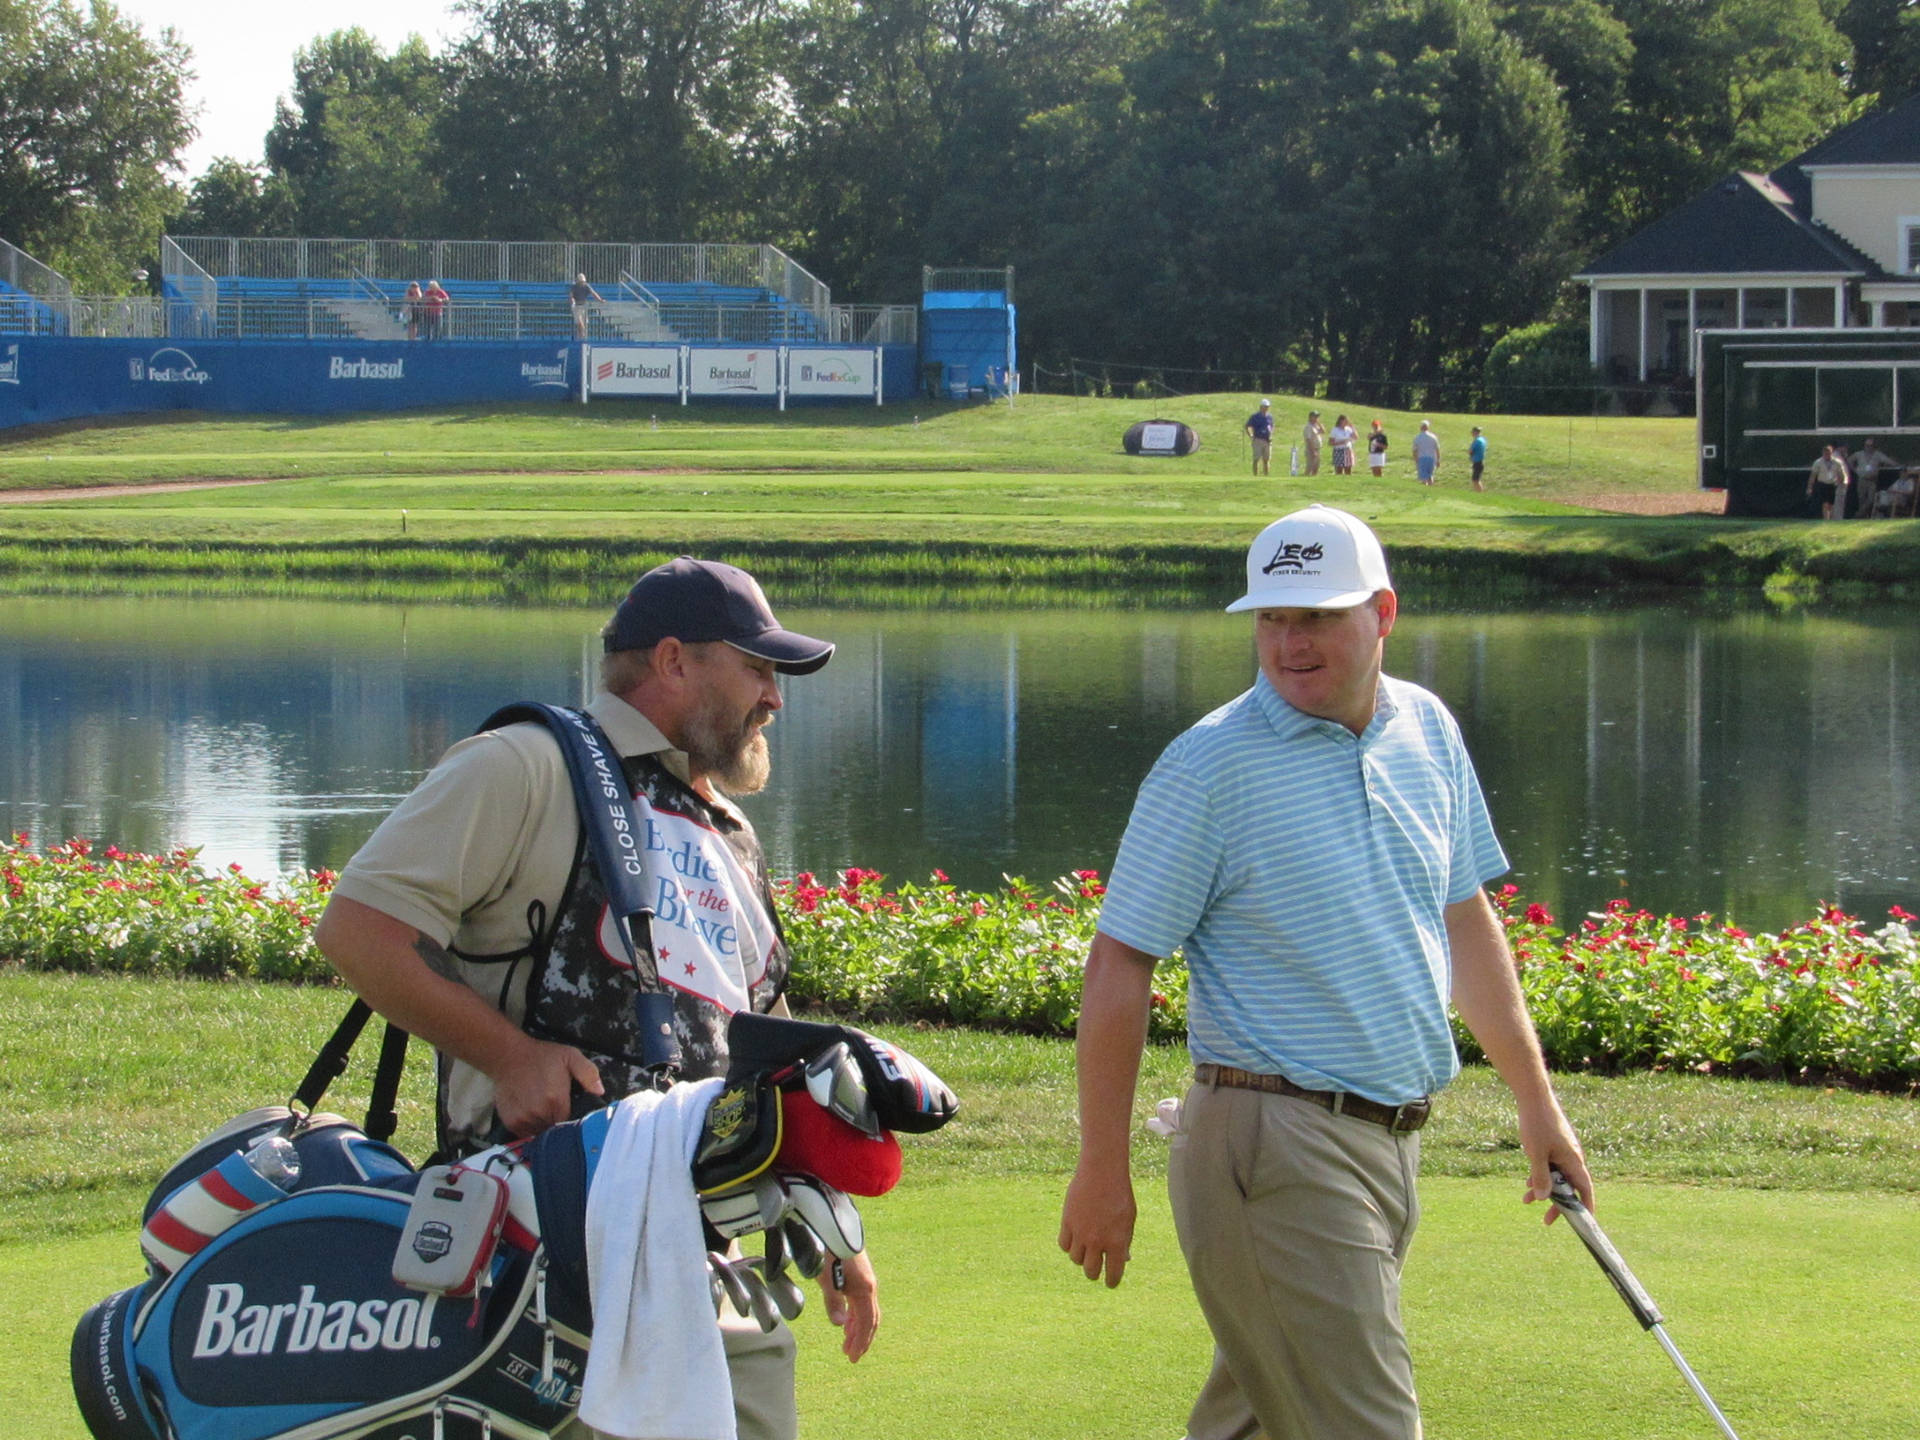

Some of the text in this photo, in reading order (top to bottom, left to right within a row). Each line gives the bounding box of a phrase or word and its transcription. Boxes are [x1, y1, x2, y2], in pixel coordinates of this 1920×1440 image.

[329, 356, 404, 378] Barbasol
[521, 362, 563, 375] Barbasol
[616, 362, 671, 379] Barbasol
[709, 366, 752, 379] Barbasol
[580, 732, 642, 876] CLOSE SHAVE
[697, 888, 729, 912] the
[191, 1282, 440, 1359] Barbasol
[505, 1360, 529, 1380] EST.
[533, 1377, 568, 1404] USA
